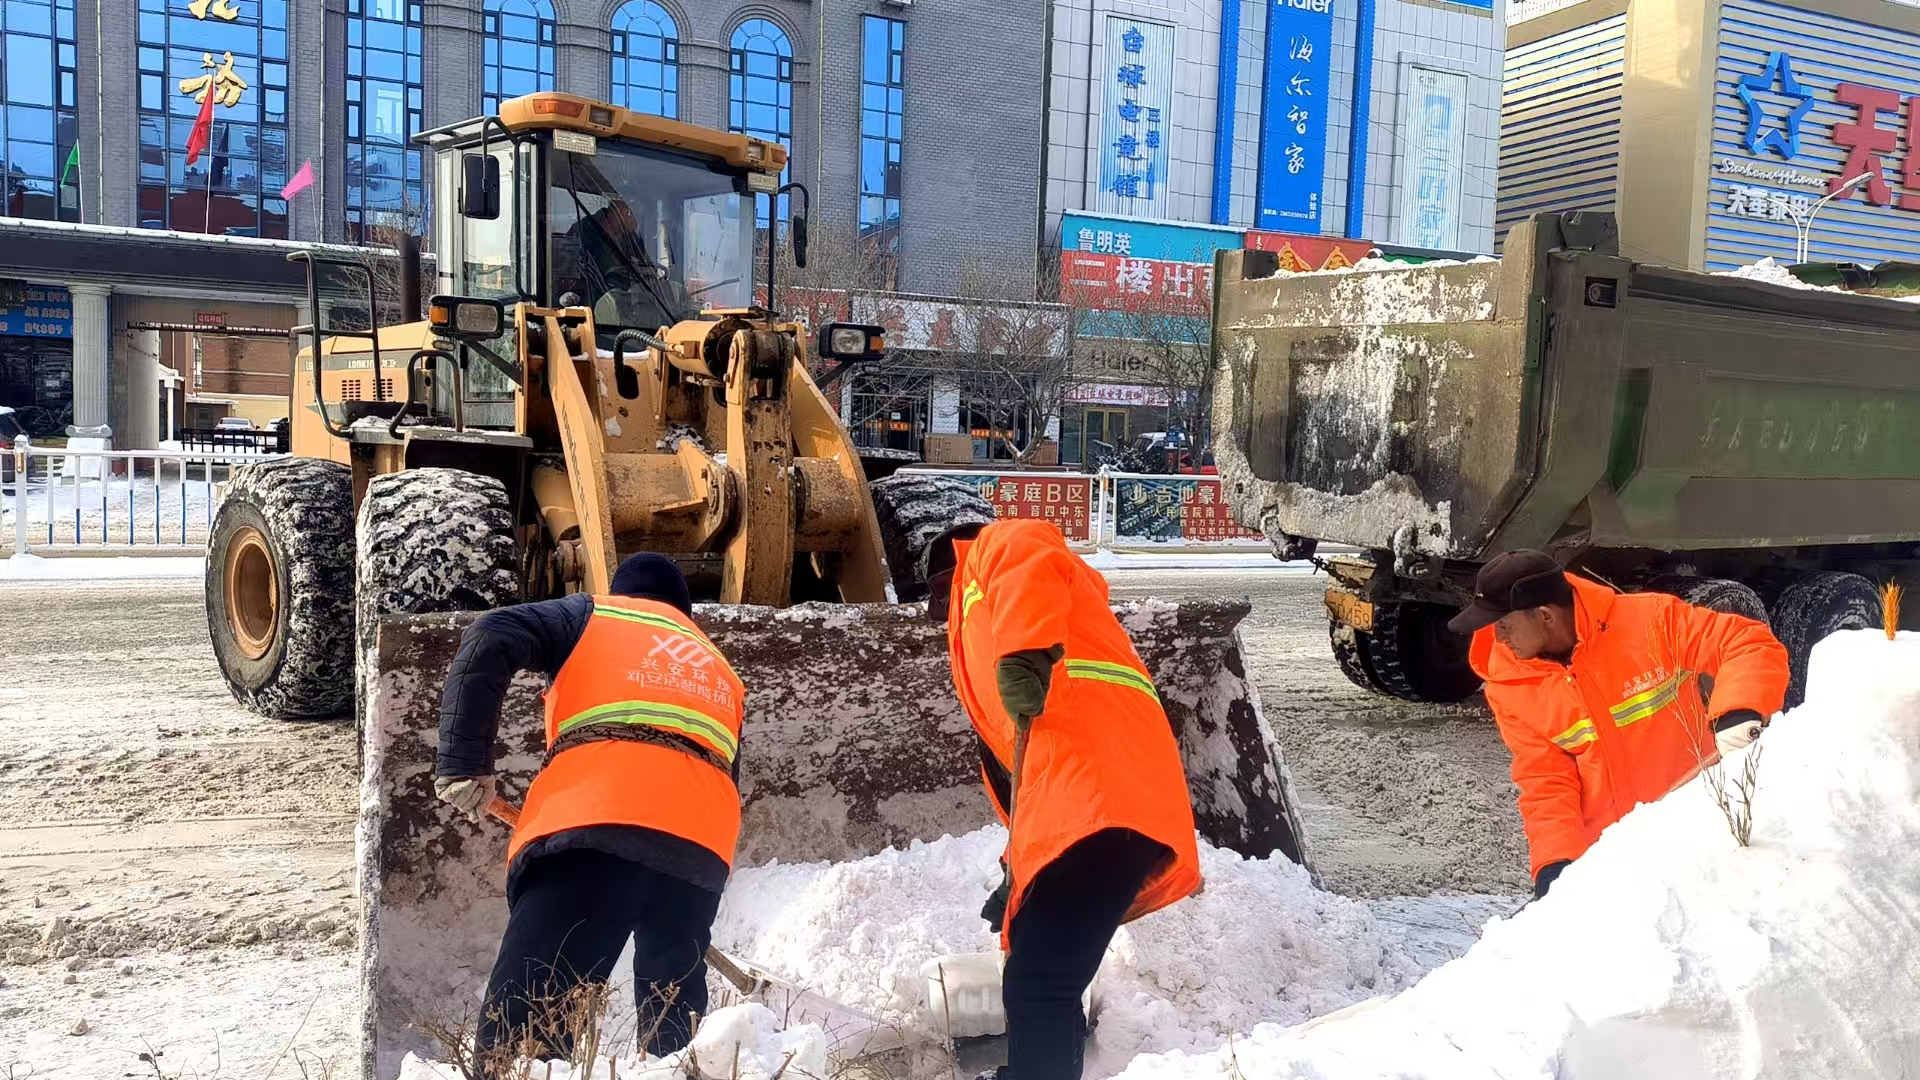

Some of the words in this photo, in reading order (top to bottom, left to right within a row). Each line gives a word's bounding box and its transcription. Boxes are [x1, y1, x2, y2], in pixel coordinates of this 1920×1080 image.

[1285, 33, 1313, 174] 海尔智家
[1078, 227, 1132, 254] 鲁明英
[1031, 505, 1085, 518] 音四中东
